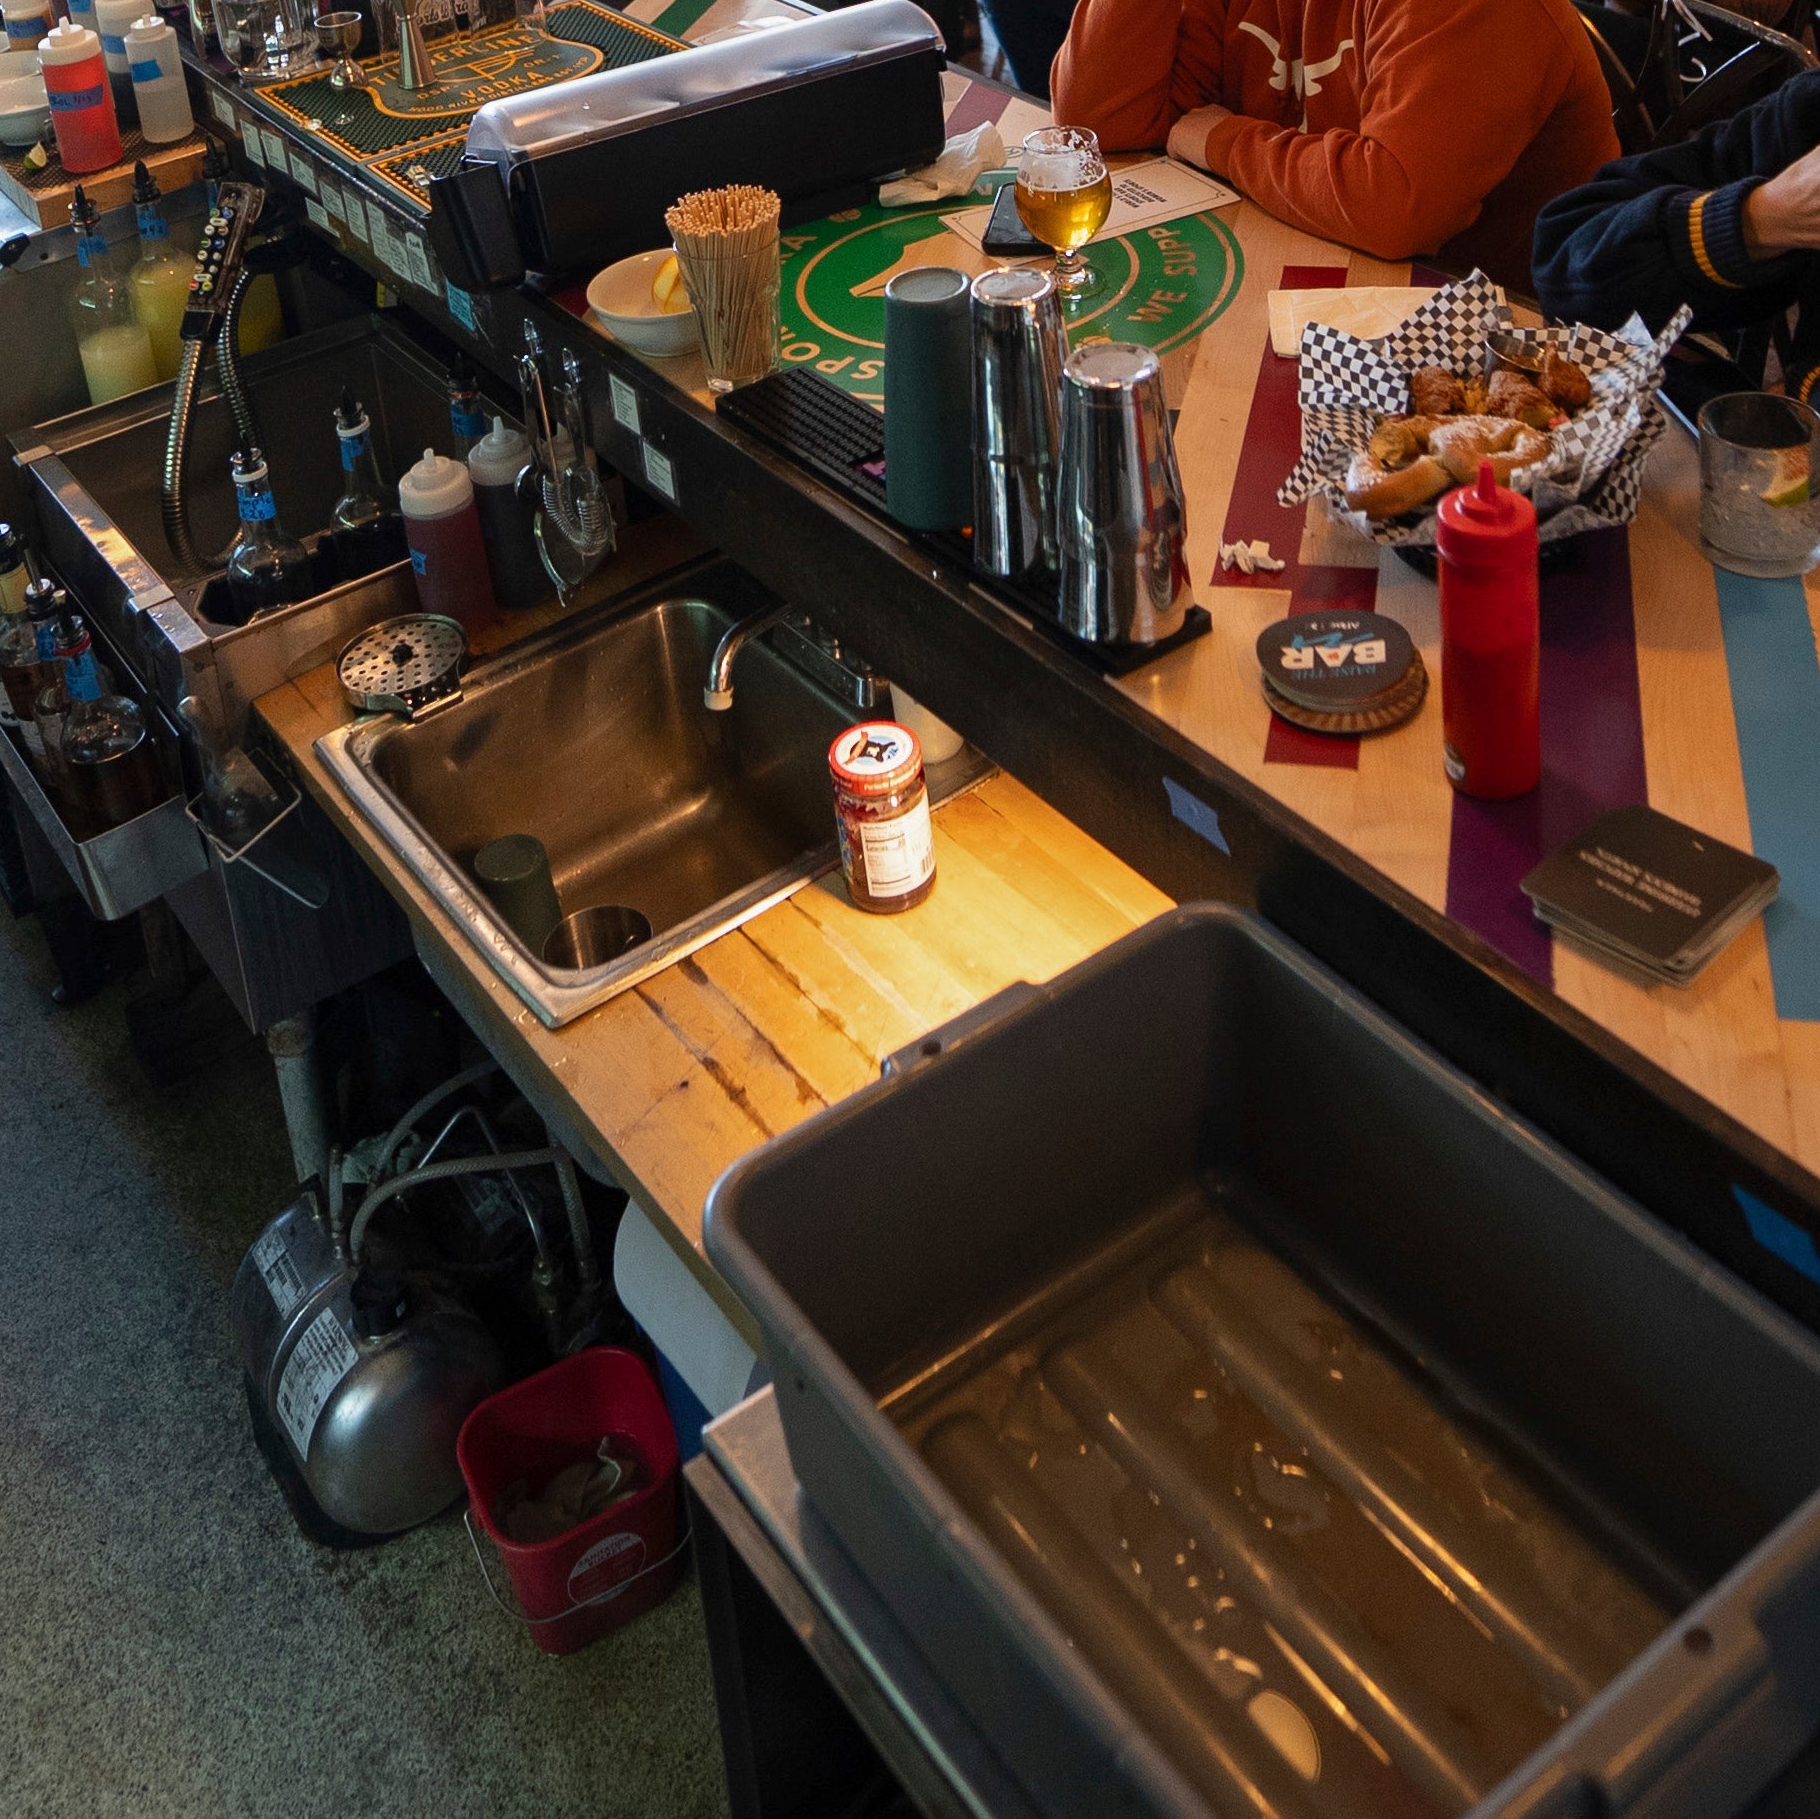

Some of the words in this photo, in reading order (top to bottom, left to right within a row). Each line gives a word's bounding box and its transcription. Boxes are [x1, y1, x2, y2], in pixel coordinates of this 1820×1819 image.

[460, 71, 546, 98] VODKA
[447, 96, 487, 109] RIVER
[1128, 288, 1188, 324] WE
[1279, 638, 1387, 670] BAR
